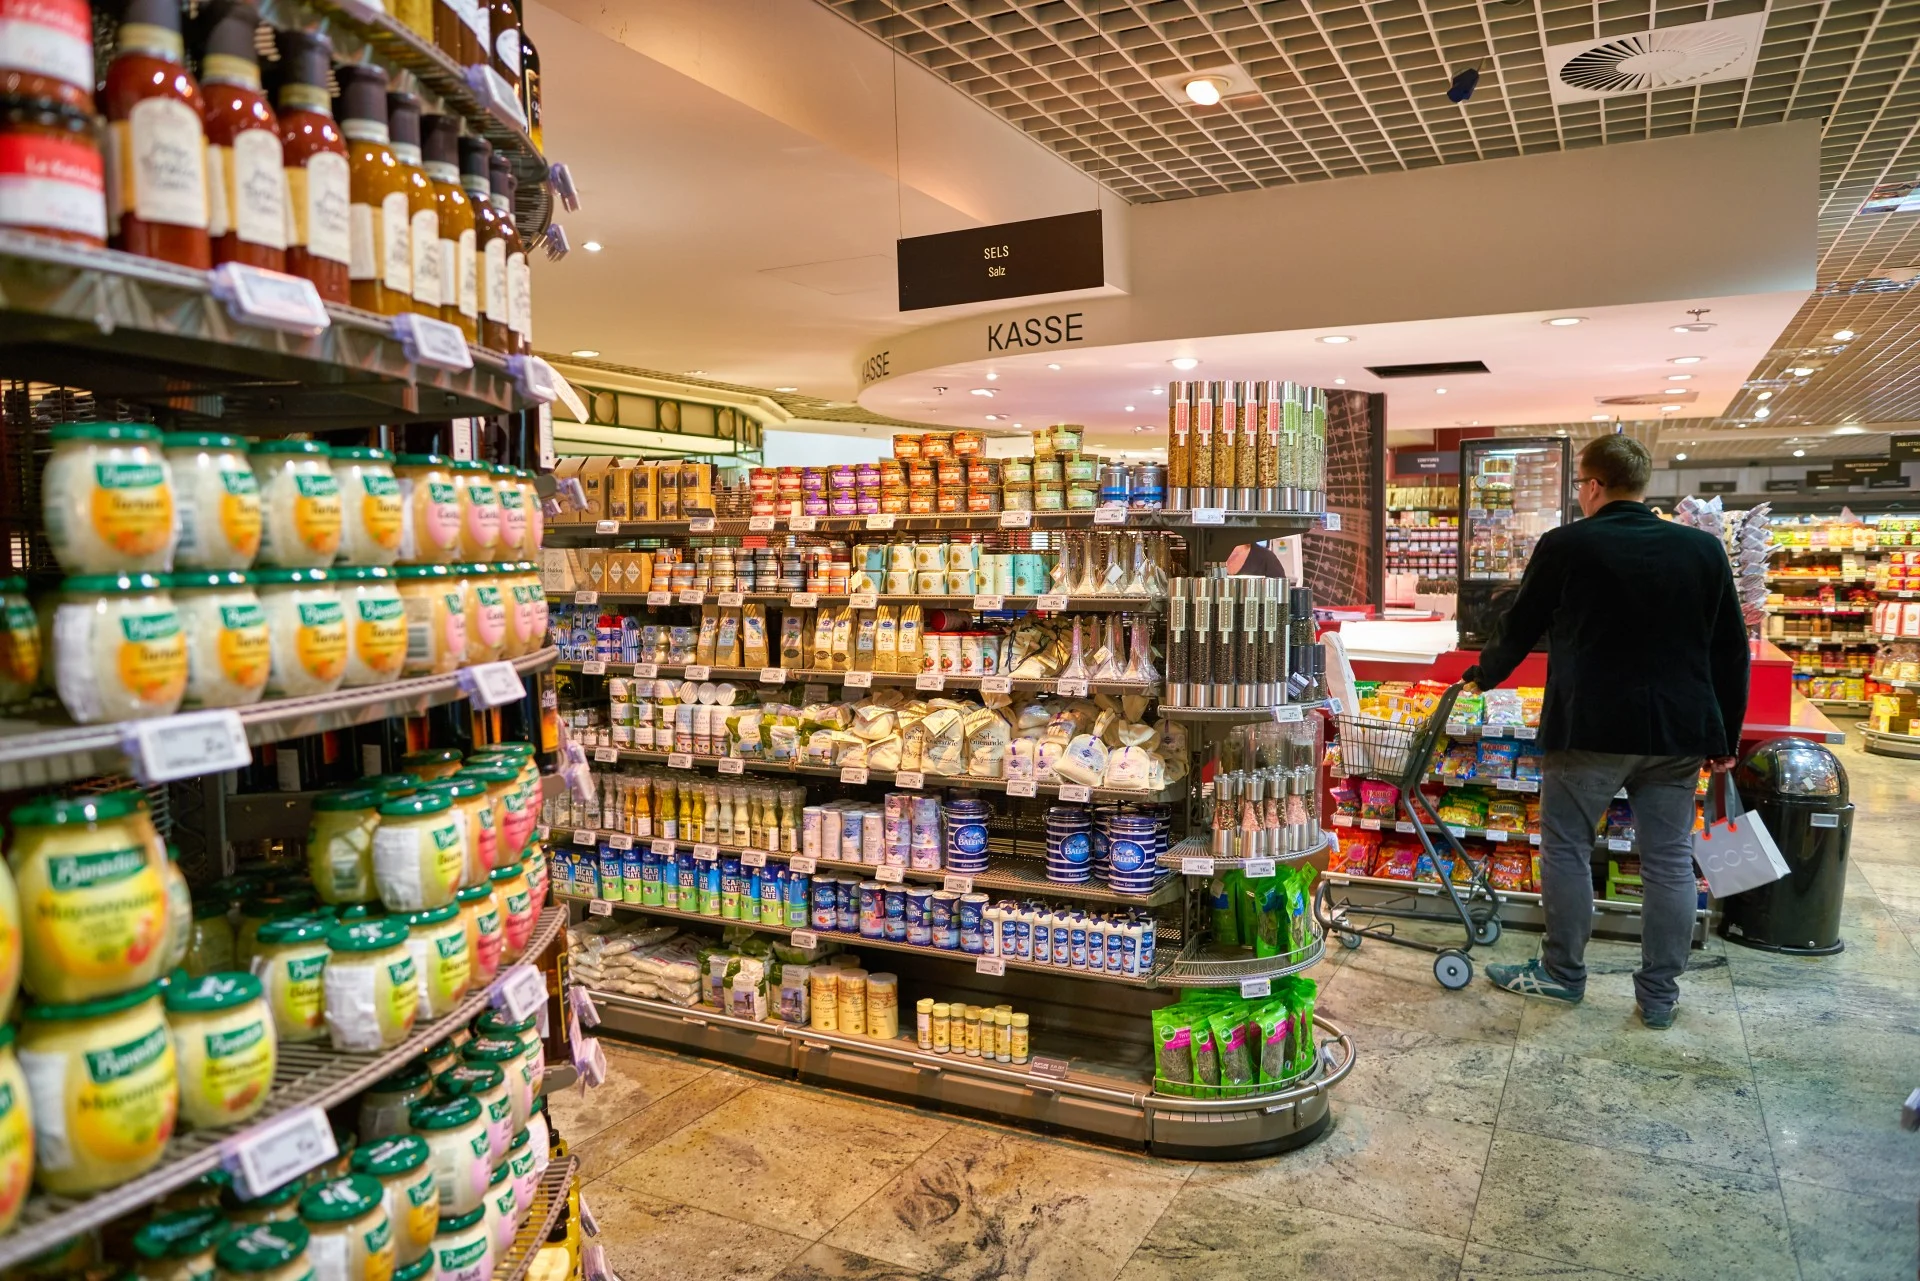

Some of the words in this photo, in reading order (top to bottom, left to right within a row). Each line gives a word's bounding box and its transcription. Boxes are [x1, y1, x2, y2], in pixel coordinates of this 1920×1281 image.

[984, 245, 1009, 260] SELS
[988, 265, 1006, 278] Salz
[988, 313, 1083, 352] KASSE
[958, 838, 986, 847] BALEINE
[1112, 854, 1141, 864] BALEINE
[1706, 843, 1758, 873] COS
